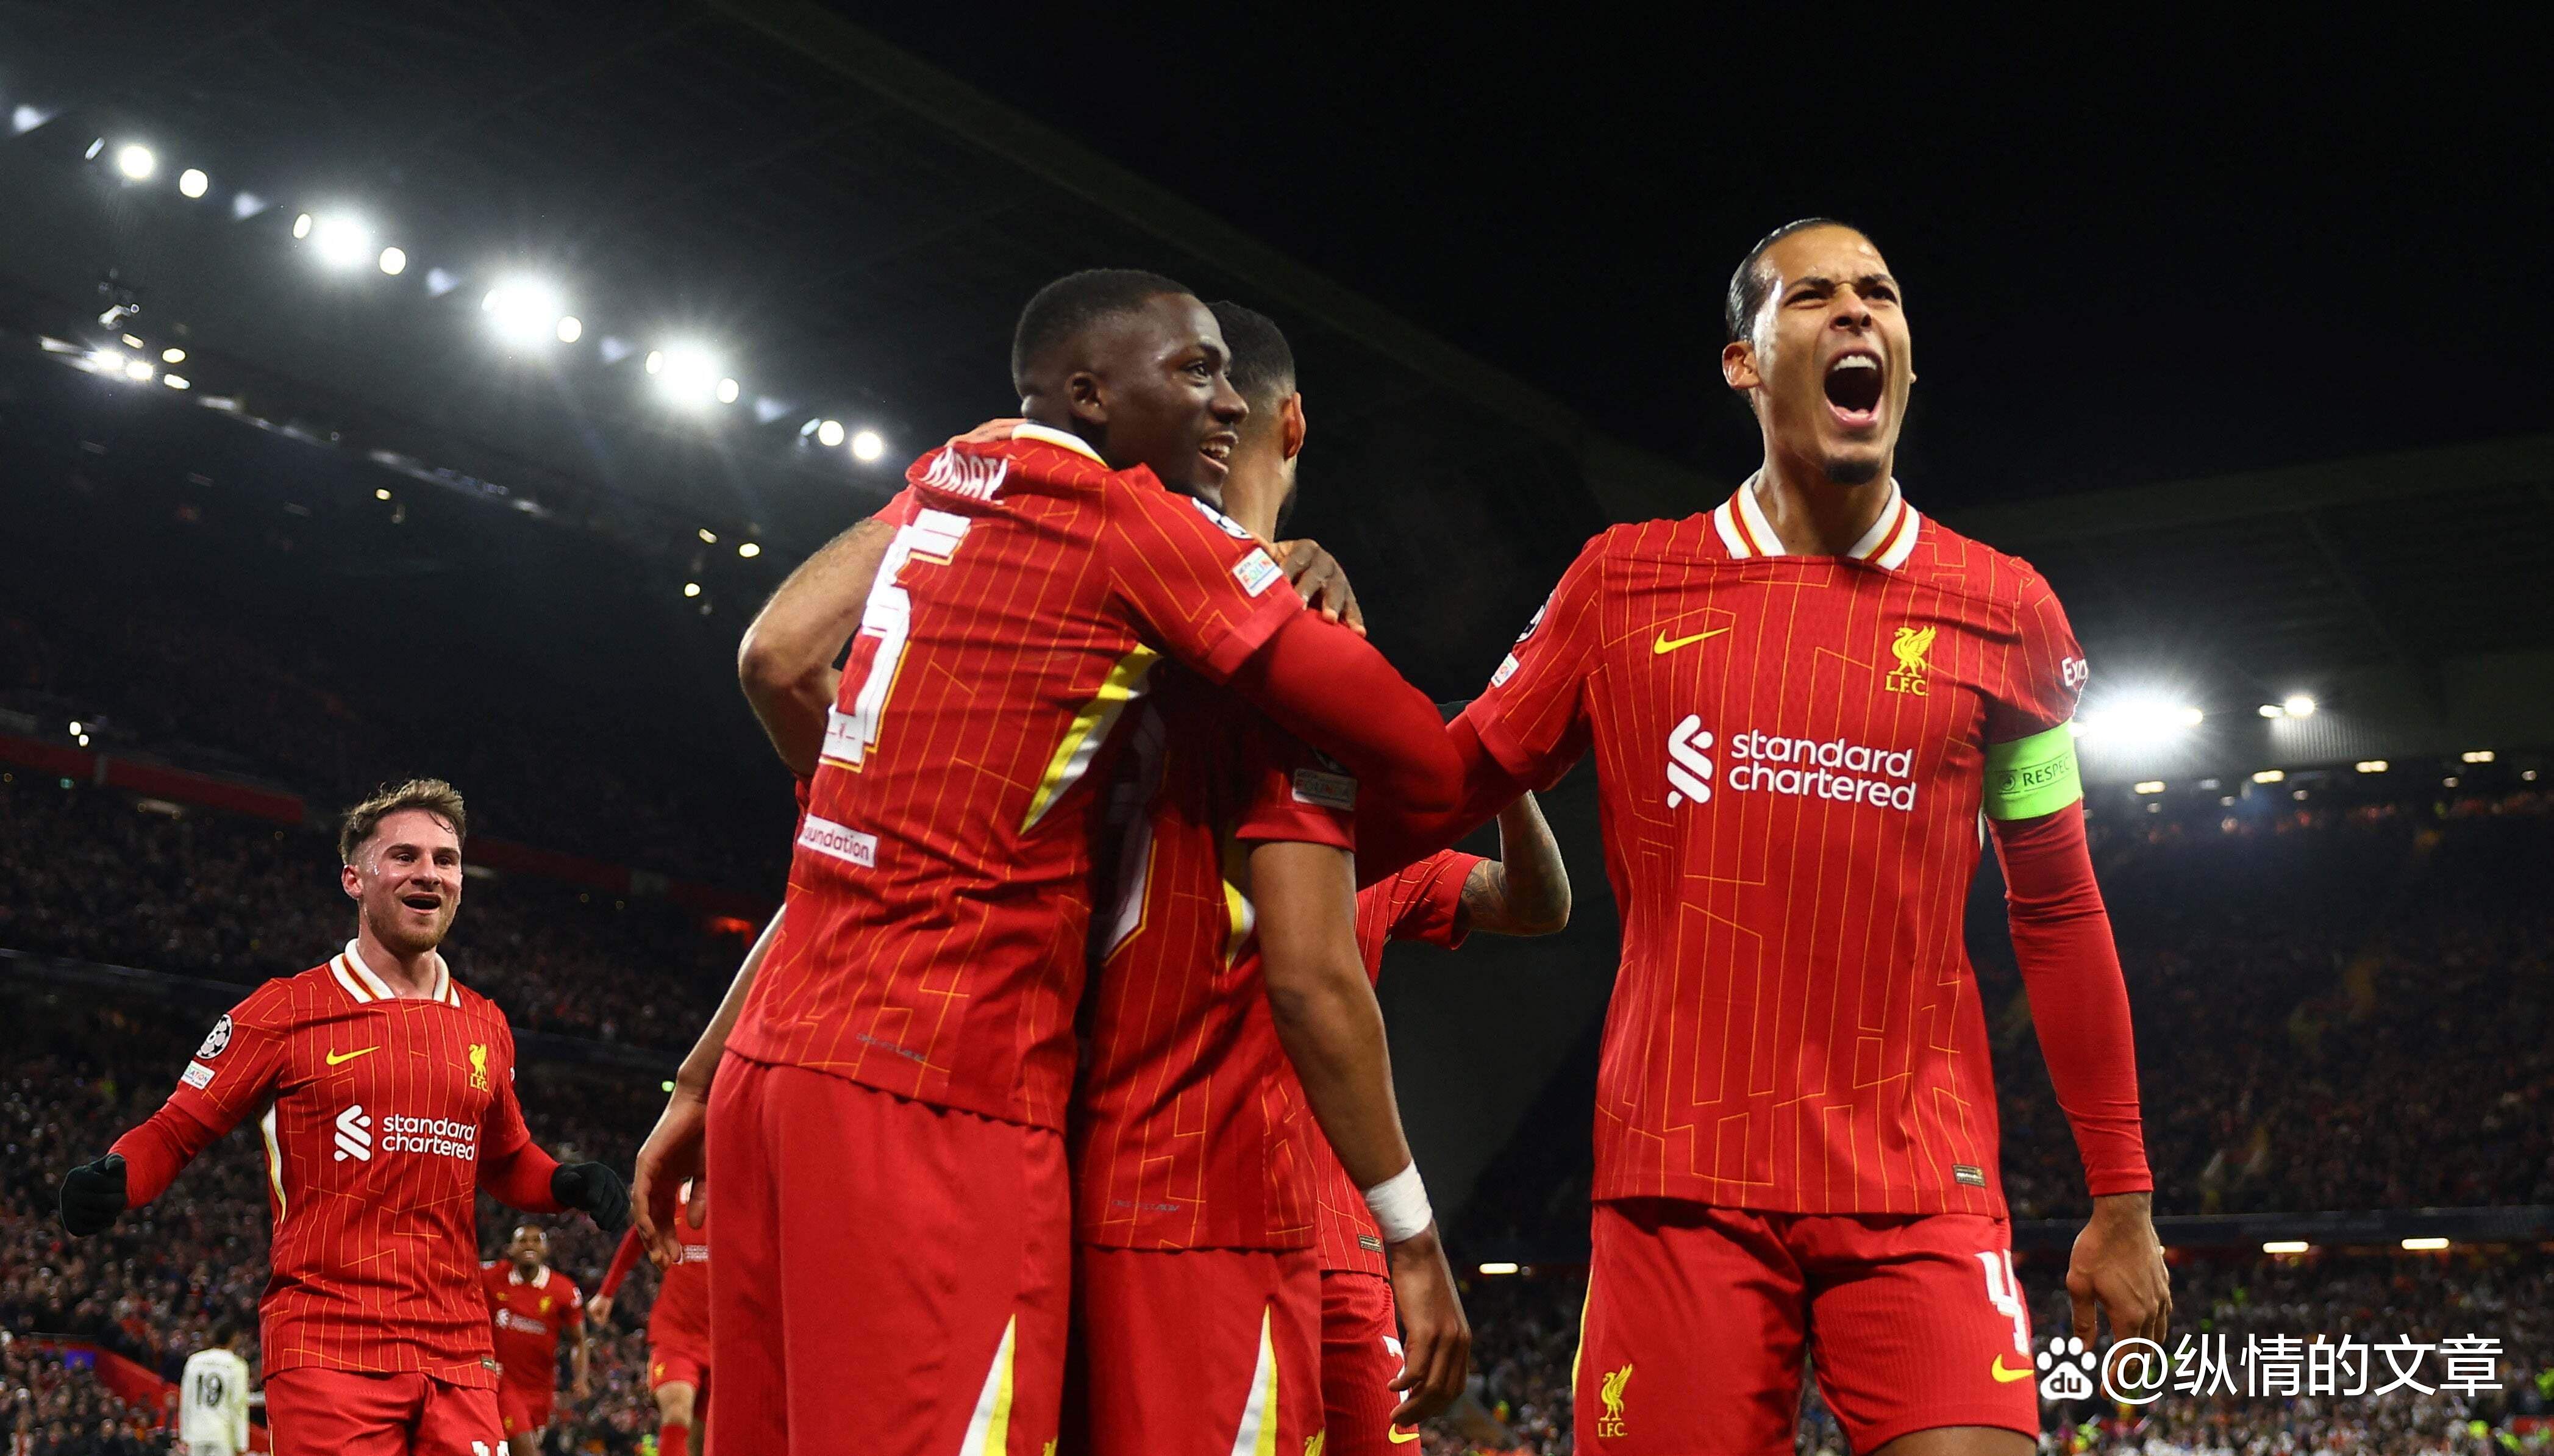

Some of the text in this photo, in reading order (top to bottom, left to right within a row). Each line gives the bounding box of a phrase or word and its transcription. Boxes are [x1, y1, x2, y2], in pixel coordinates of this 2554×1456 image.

[819, 508, 971, 772] 5
[1885, 675, 1929, 696] L.F.C.
[1731, 729, 1912, 779] standard
[1729, 762, 1916, 811] chartered
[2022, 757, 2071, 787] RESPEC
[804, 826, 869, 860] oundation
[383, 1113, 477, 1141] standard
[382, 1132, 476, 1162] chartered
[1974, 1248, 2030, 1359] 4
[196, 1372, 223, 1407] 19
